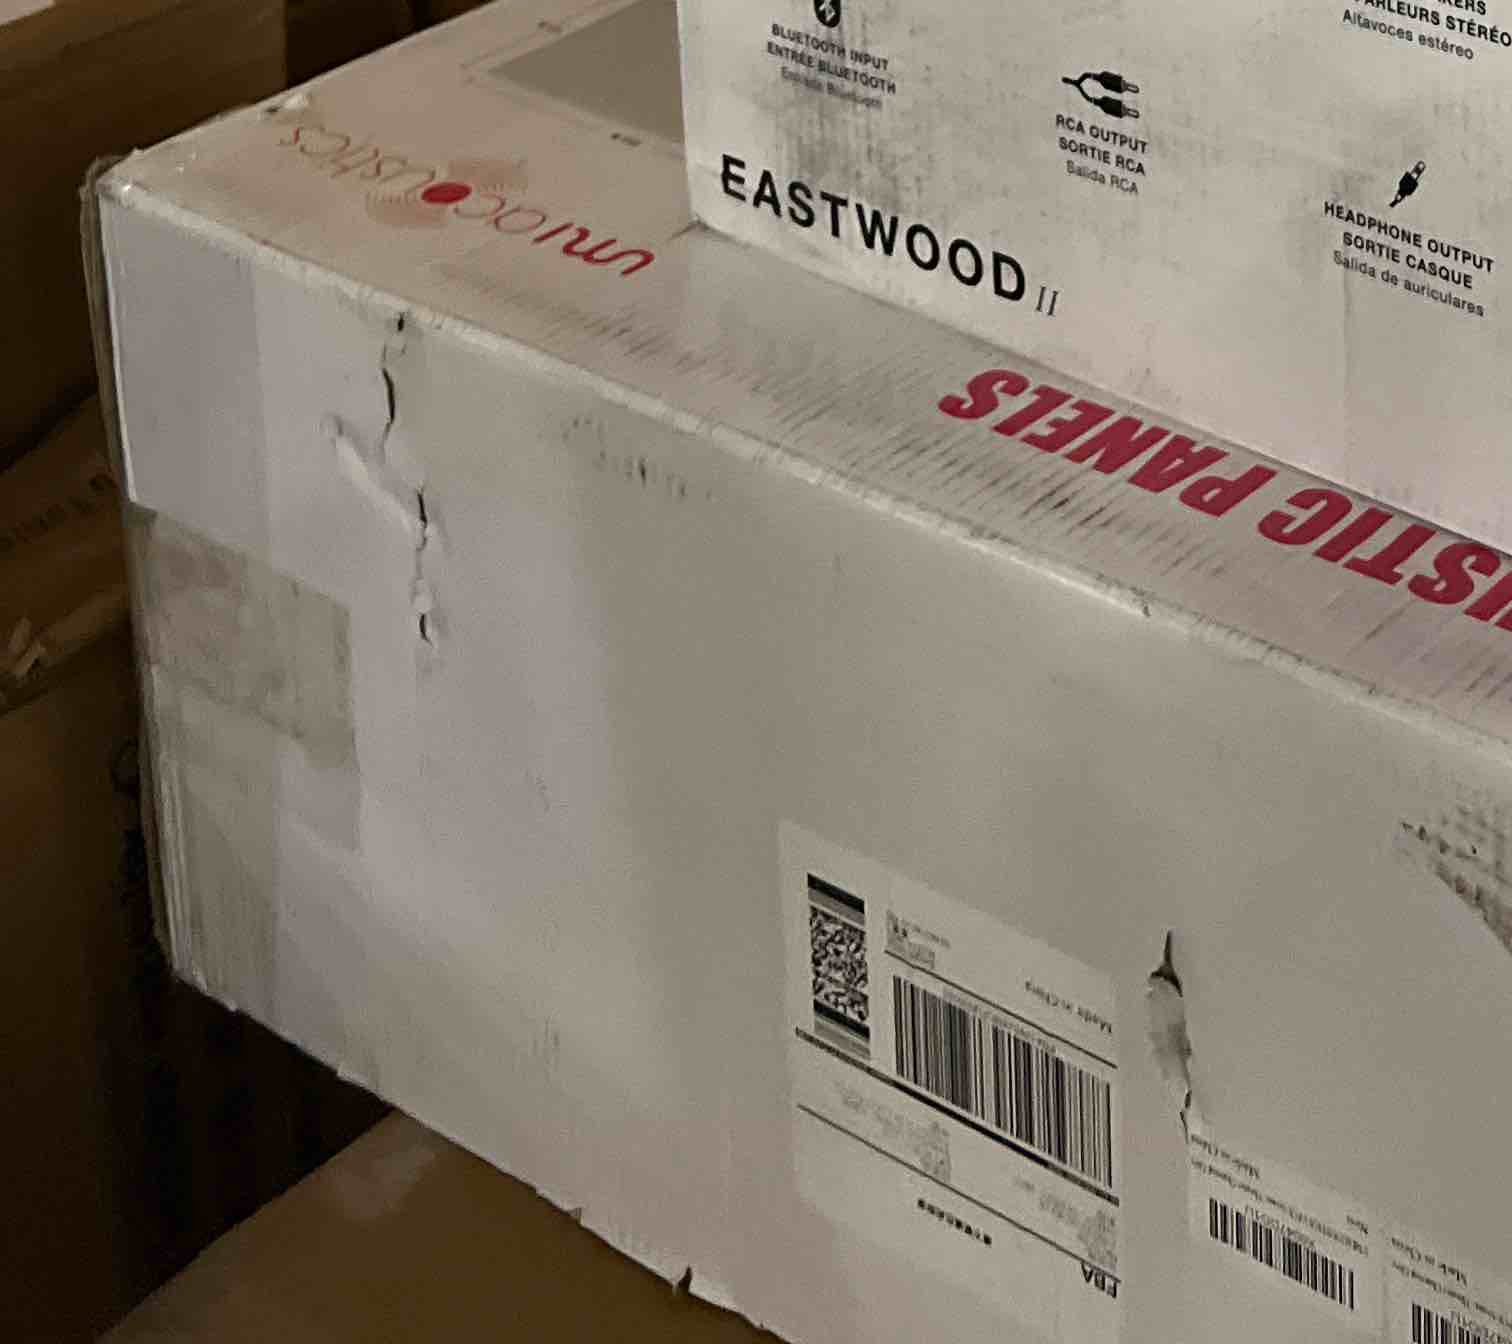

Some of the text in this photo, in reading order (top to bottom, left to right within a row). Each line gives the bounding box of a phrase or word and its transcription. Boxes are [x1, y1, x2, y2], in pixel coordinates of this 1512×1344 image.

[772, 23, 888, 70] BLUETOOTH INPUT
[1342, 9, 1474, 60] Altavoces estéreo
[1446, 13, 1512, 47] STÉRÉO
[818, 60, 896, 94] BLUETOOTH
[1056, 113, 1149, 155] RCA OUTPUT
[1059, 137, 1146, 177] SORTIE RCA
[1066, 160, 1139, 195] Salida RCA
[721, 152, 1059, 317] EASTWOOD II
[1324, 200, 1495, 274] HEADPHONE OUTPUT
[1333, 249, 1485, 317] Salida de auriculares
[1343, 232, 1473, 289] SORTIE CASQUE
[939, 369, 1278, 520] PANELS
